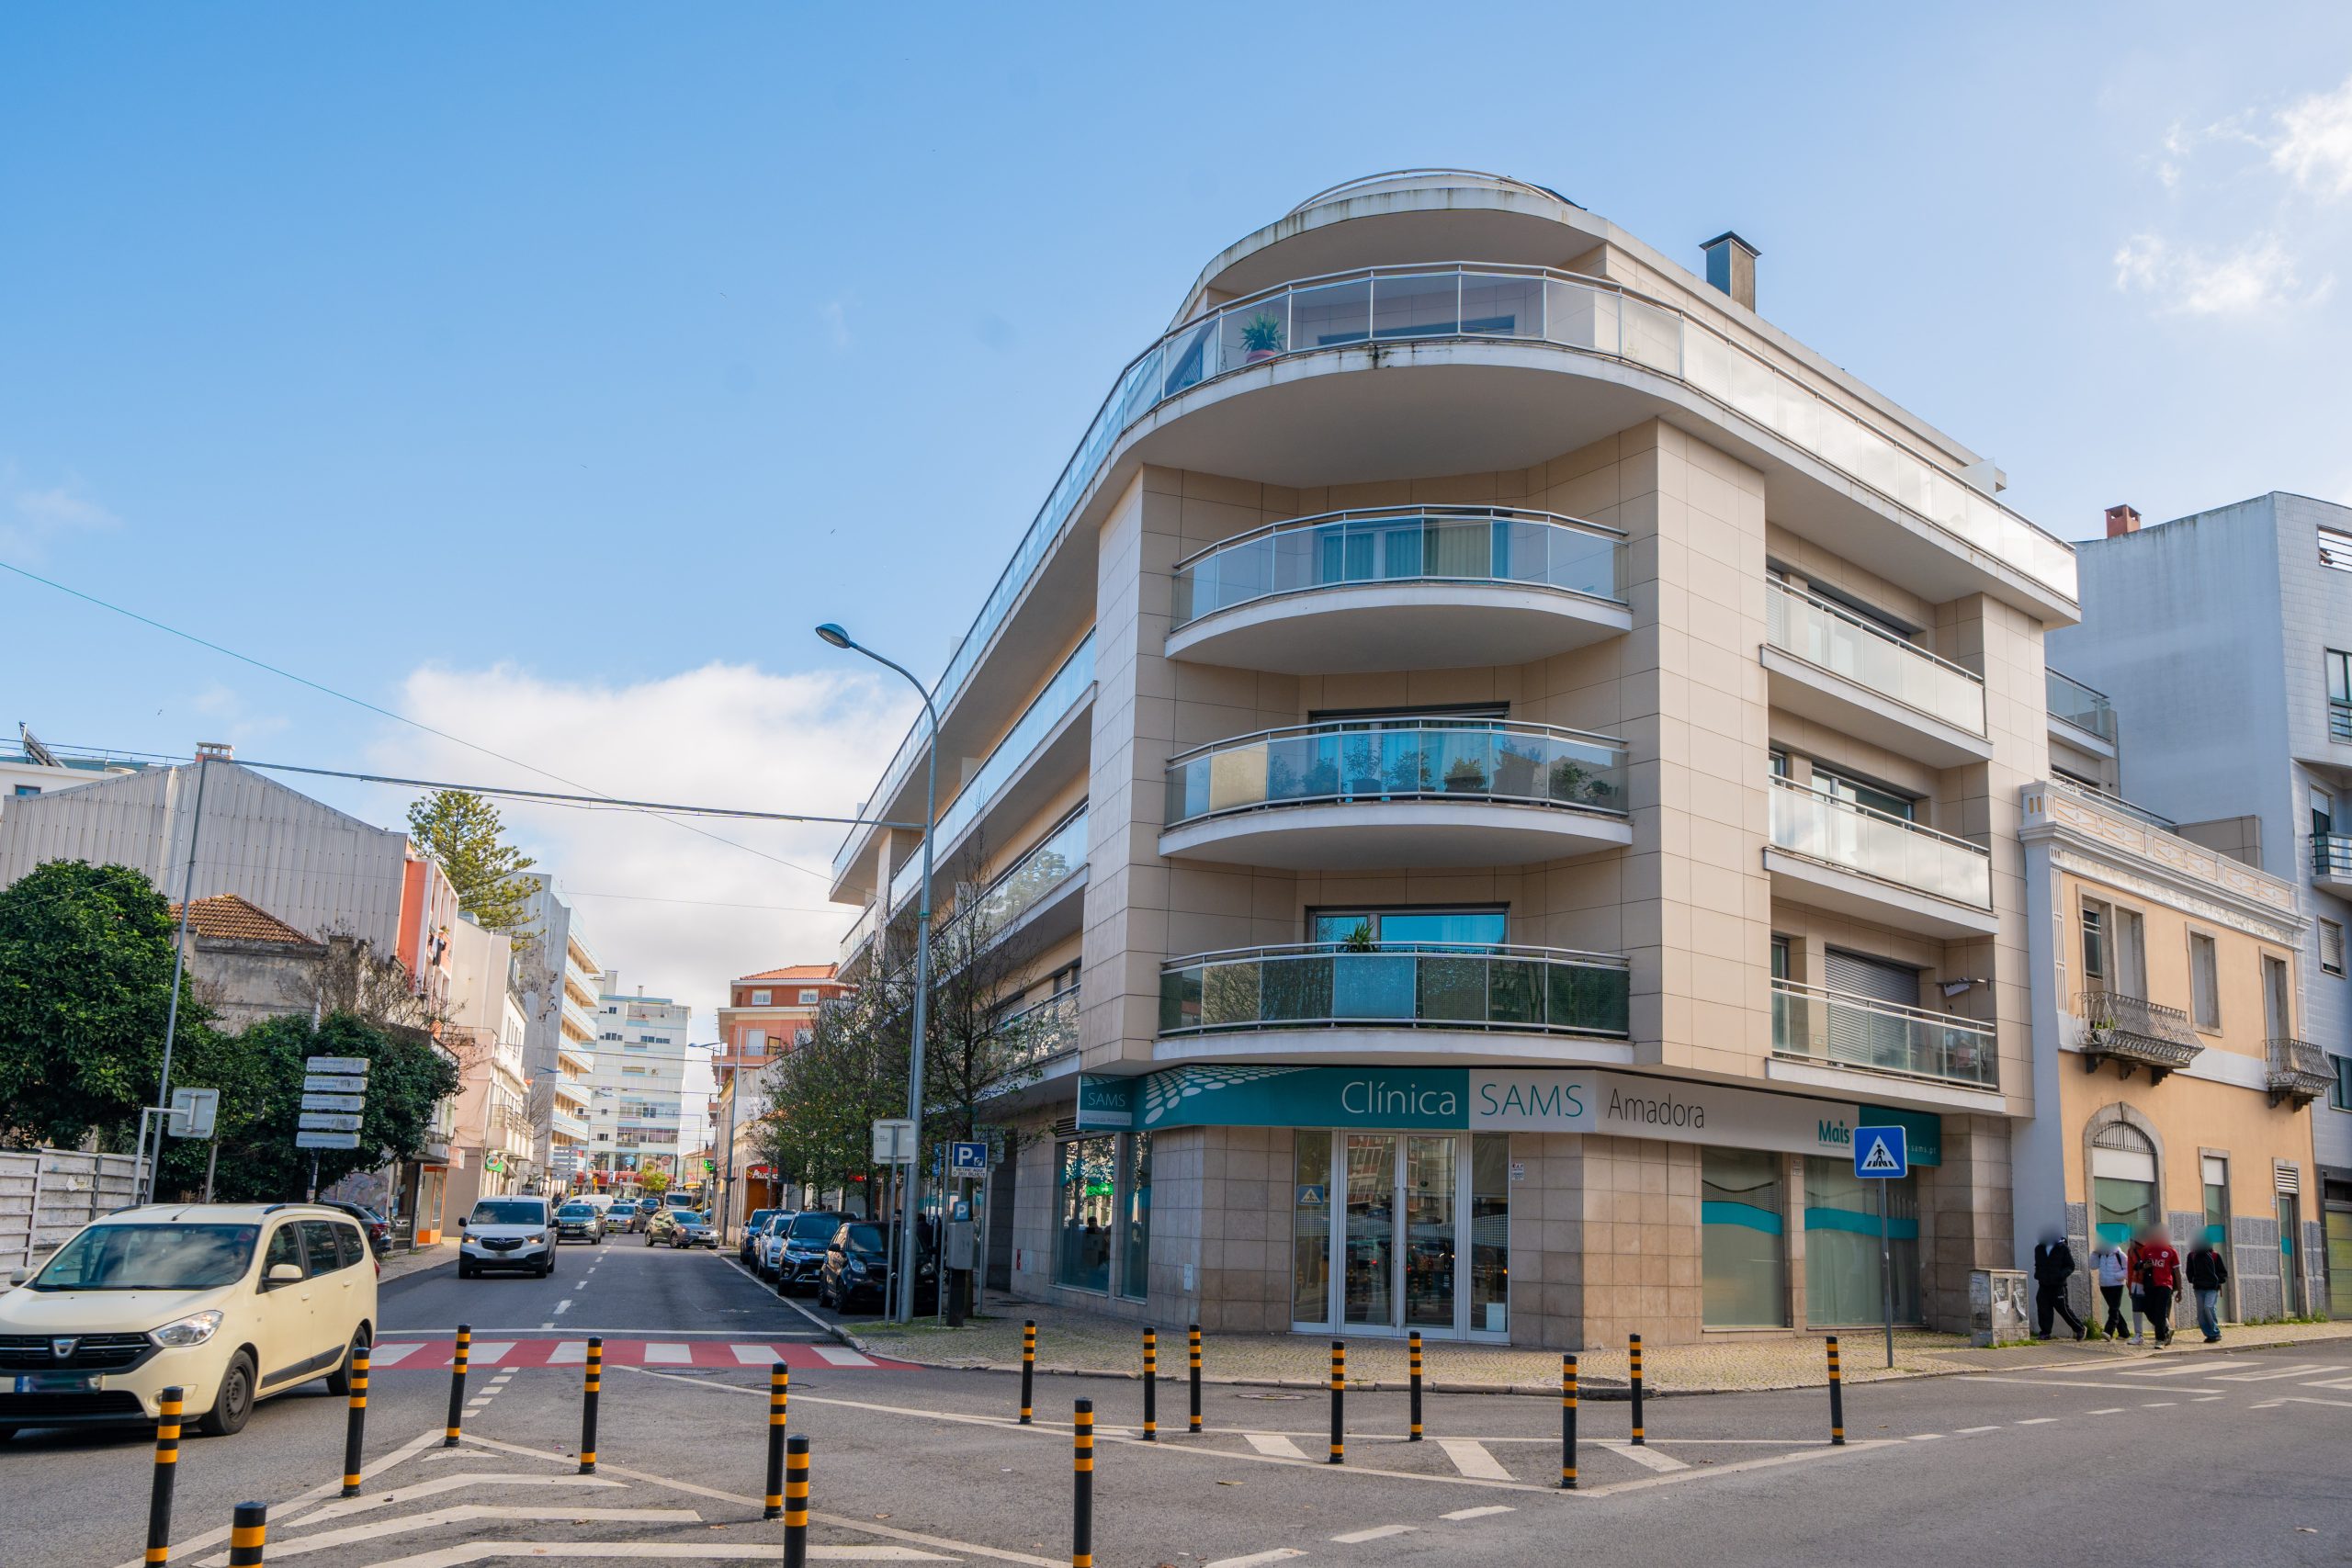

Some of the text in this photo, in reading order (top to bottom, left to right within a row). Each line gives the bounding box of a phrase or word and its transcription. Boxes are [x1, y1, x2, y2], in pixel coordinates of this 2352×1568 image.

[1088, 1092, 1125, 1107] SAMS
[1341, 1080, 1704, 1129] Clínica SAMS Amadora
[1818, 1119, 1849, 1145] Mais
[958, 1146, 973, 1166] P
[956, 1203, 967, 1217] P
